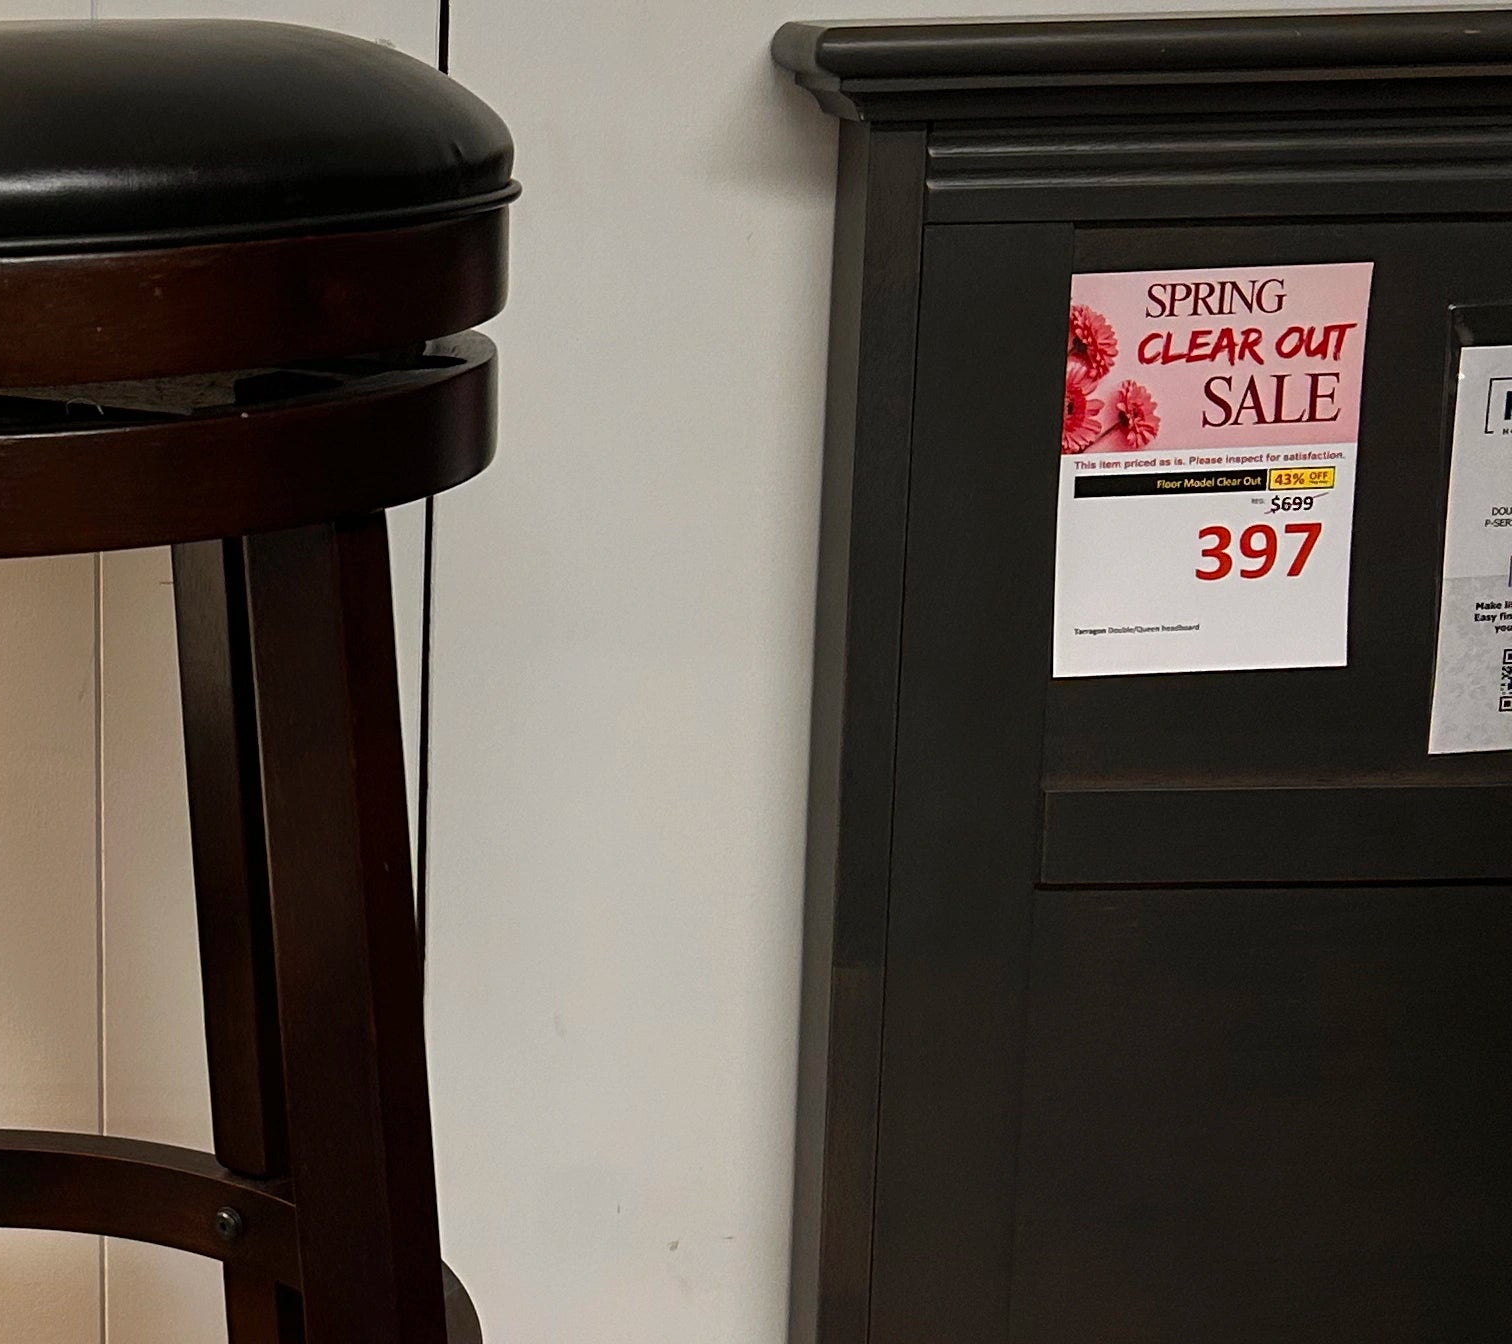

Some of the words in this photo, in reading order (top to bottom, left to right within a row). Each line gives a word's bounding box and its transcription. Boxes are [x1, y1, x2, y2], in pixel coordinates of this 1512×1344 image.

[1145, 278, 1287, 319] SPRING
[1137, 327, 1265, 366] CLEAR
[1275, 323, 1357, 362] OUT
[1202, 372, 1342, 429] SALE
[1074, 460, 1096, 471] This
[1099, 459, 1121, 469] item
[1124, 457, 1156, 470] priced
[1159, 458, 1171, 466] as
[1174, 456, 1186, 466] is.
[1189, 455, 1223, 465] Please
[1226, 454, 1263, 466] inspect
[1266, 453, 1280, 463] for
[1284, 451, 1346, 462] satisfaction.
[1156, 479, 1181, 489] Floor
[1184, 477, 1215, 488] Model
[1216, 475, 1241, 487] Clear
[1244, 475, 1262, 486] Out
[1274, 473, 1305, 486] 43%
[1309, 471, 1328, 480] OFF
[1271, 495, 1314, 513] $699
[1194, 522, 1323, 581] 397
[1475, 600, 1503, 611] Make
[1474, 613, 1497, 624] Easy
